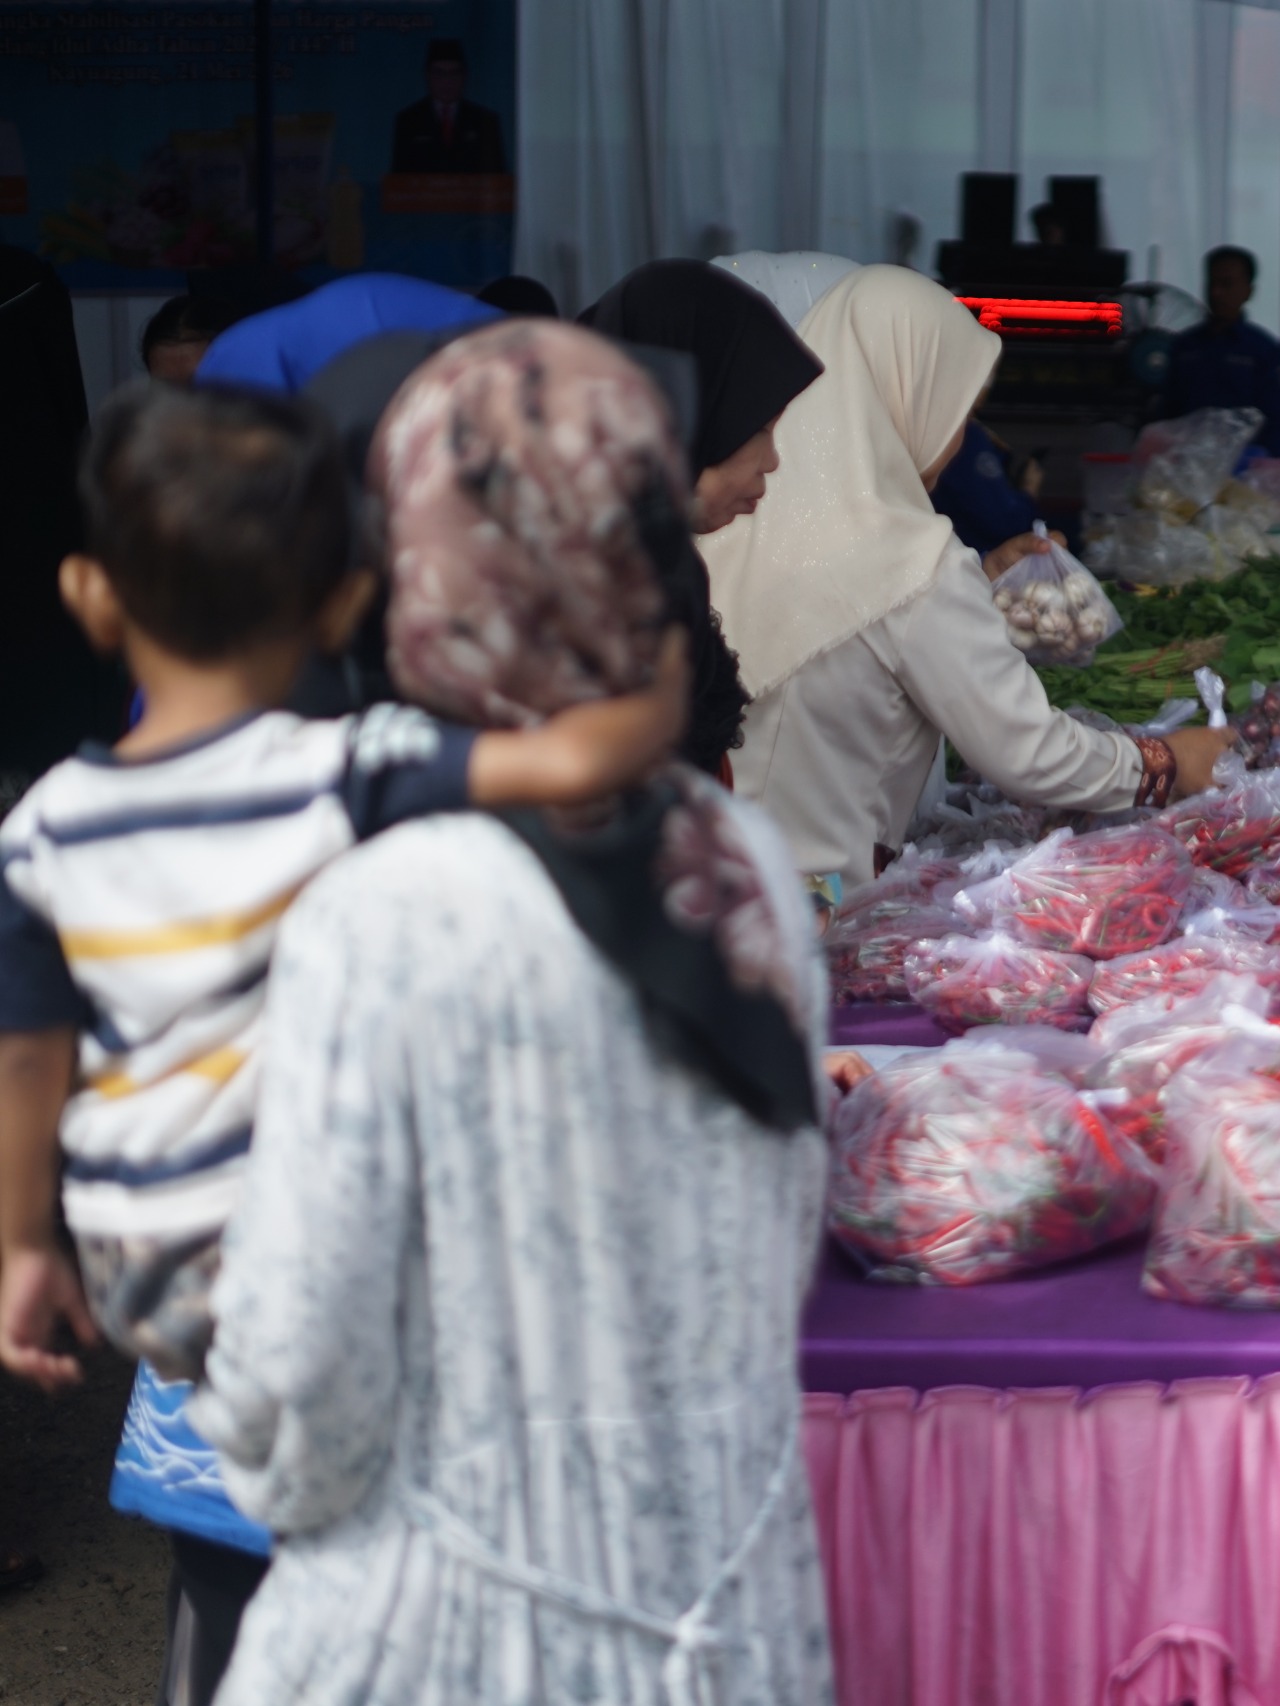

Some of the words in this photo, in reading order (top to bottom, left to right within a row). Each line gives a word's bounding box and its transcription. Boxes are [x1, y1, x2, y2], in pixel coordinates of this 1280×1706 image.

[0, 11, 50, 35] ngka
[295, 10, 356, 32] Harga
[362, 10, 434, 32] Pangan
[222, 34, 259, 54] 202
[246, 61, 294, 79] 226
